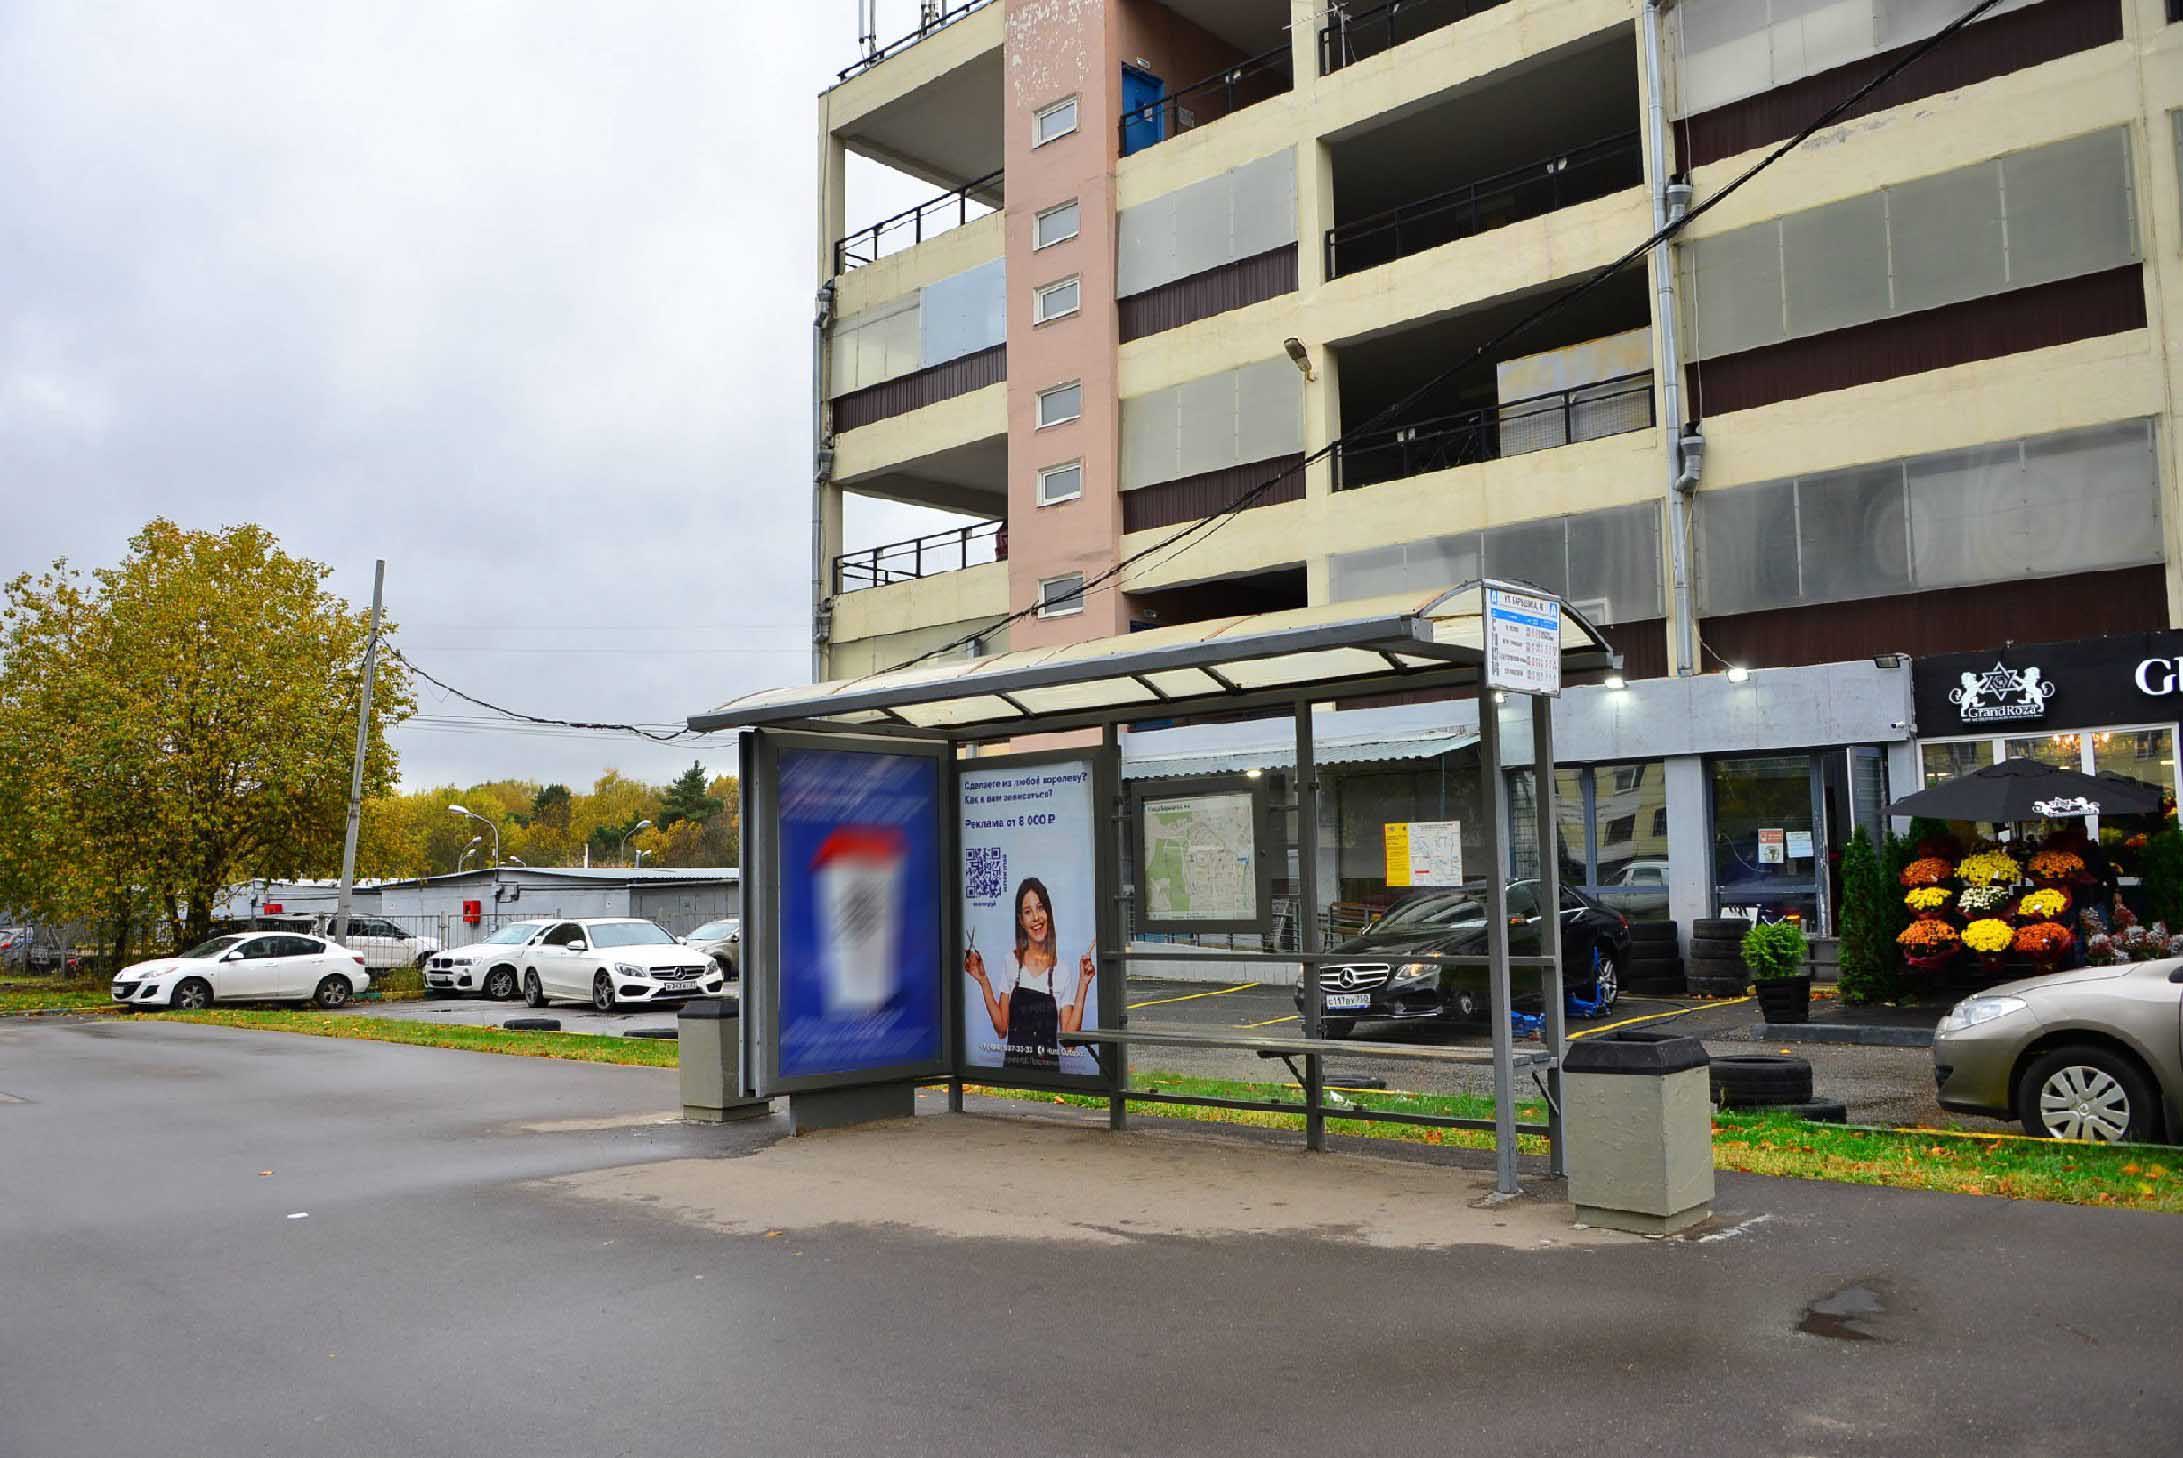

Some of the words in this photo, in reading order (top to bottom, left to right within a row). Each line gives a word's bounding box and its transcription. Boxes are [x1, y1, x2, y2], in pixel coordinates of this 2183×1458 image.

[1968, 704, 2036, 718] GrandRoza
[964, 781, 1001, 791] Сделаете
[1002, 780, 1012, 788] из
[1014, 775, 1040, 787] любой
[1043, 772, 1088, 786] королеву?
[964, 795, 979, 805] Как
[986, 795, 1001, 804] вам
[1002, 789, 1053, 803] записаться?
[965, 819, 1004, 830] Реклама
[1006, 819, 1016, 827] от
